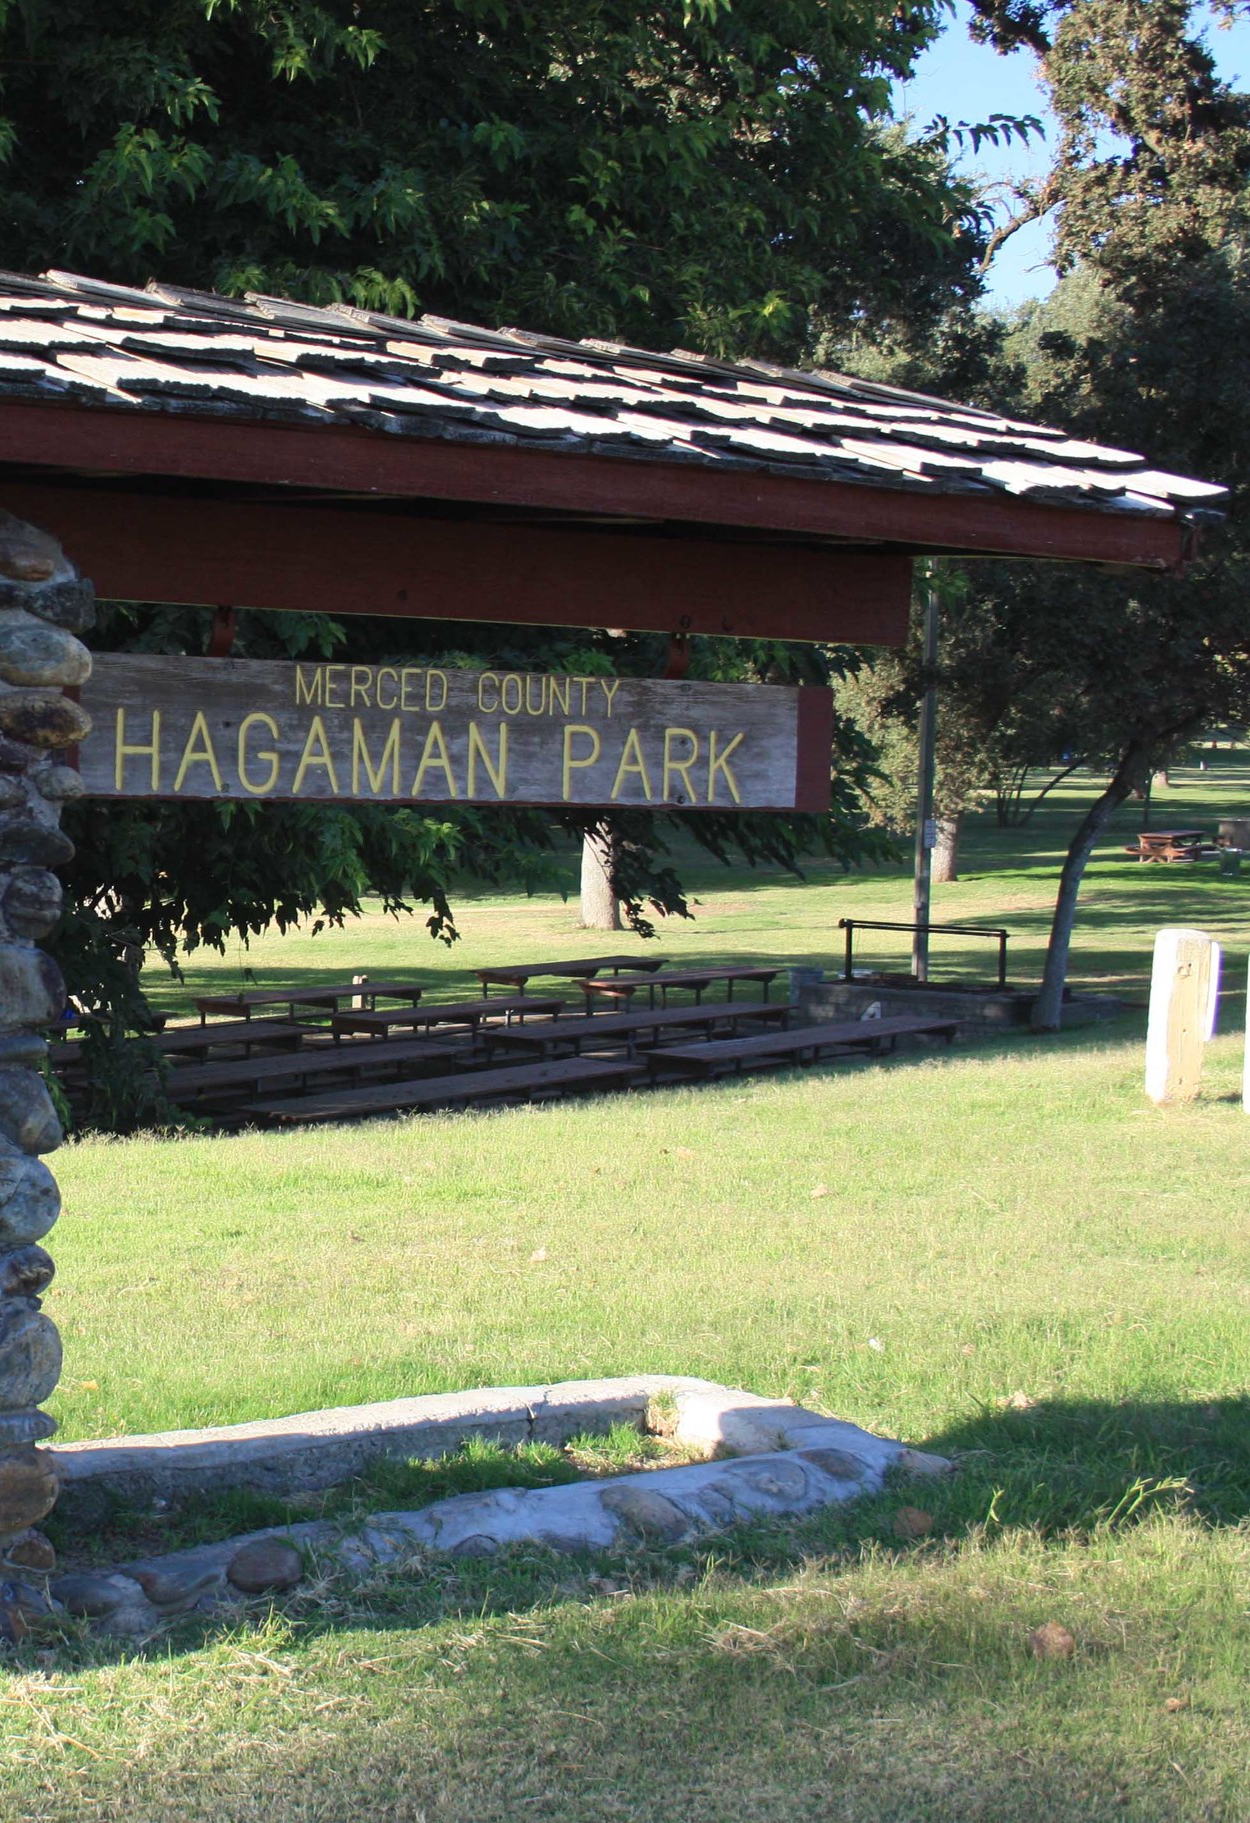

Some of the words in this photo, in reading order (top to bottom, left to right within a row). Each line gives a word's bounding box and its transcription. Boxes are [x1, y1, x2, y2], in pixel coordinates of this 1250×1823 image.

[295, 664, 448, 712] MERCED
[477, 672, 620, 719] COUNTY
[115, 707, 508, 799] HAGAMAN
[562, 724, 744, 804] PARK
